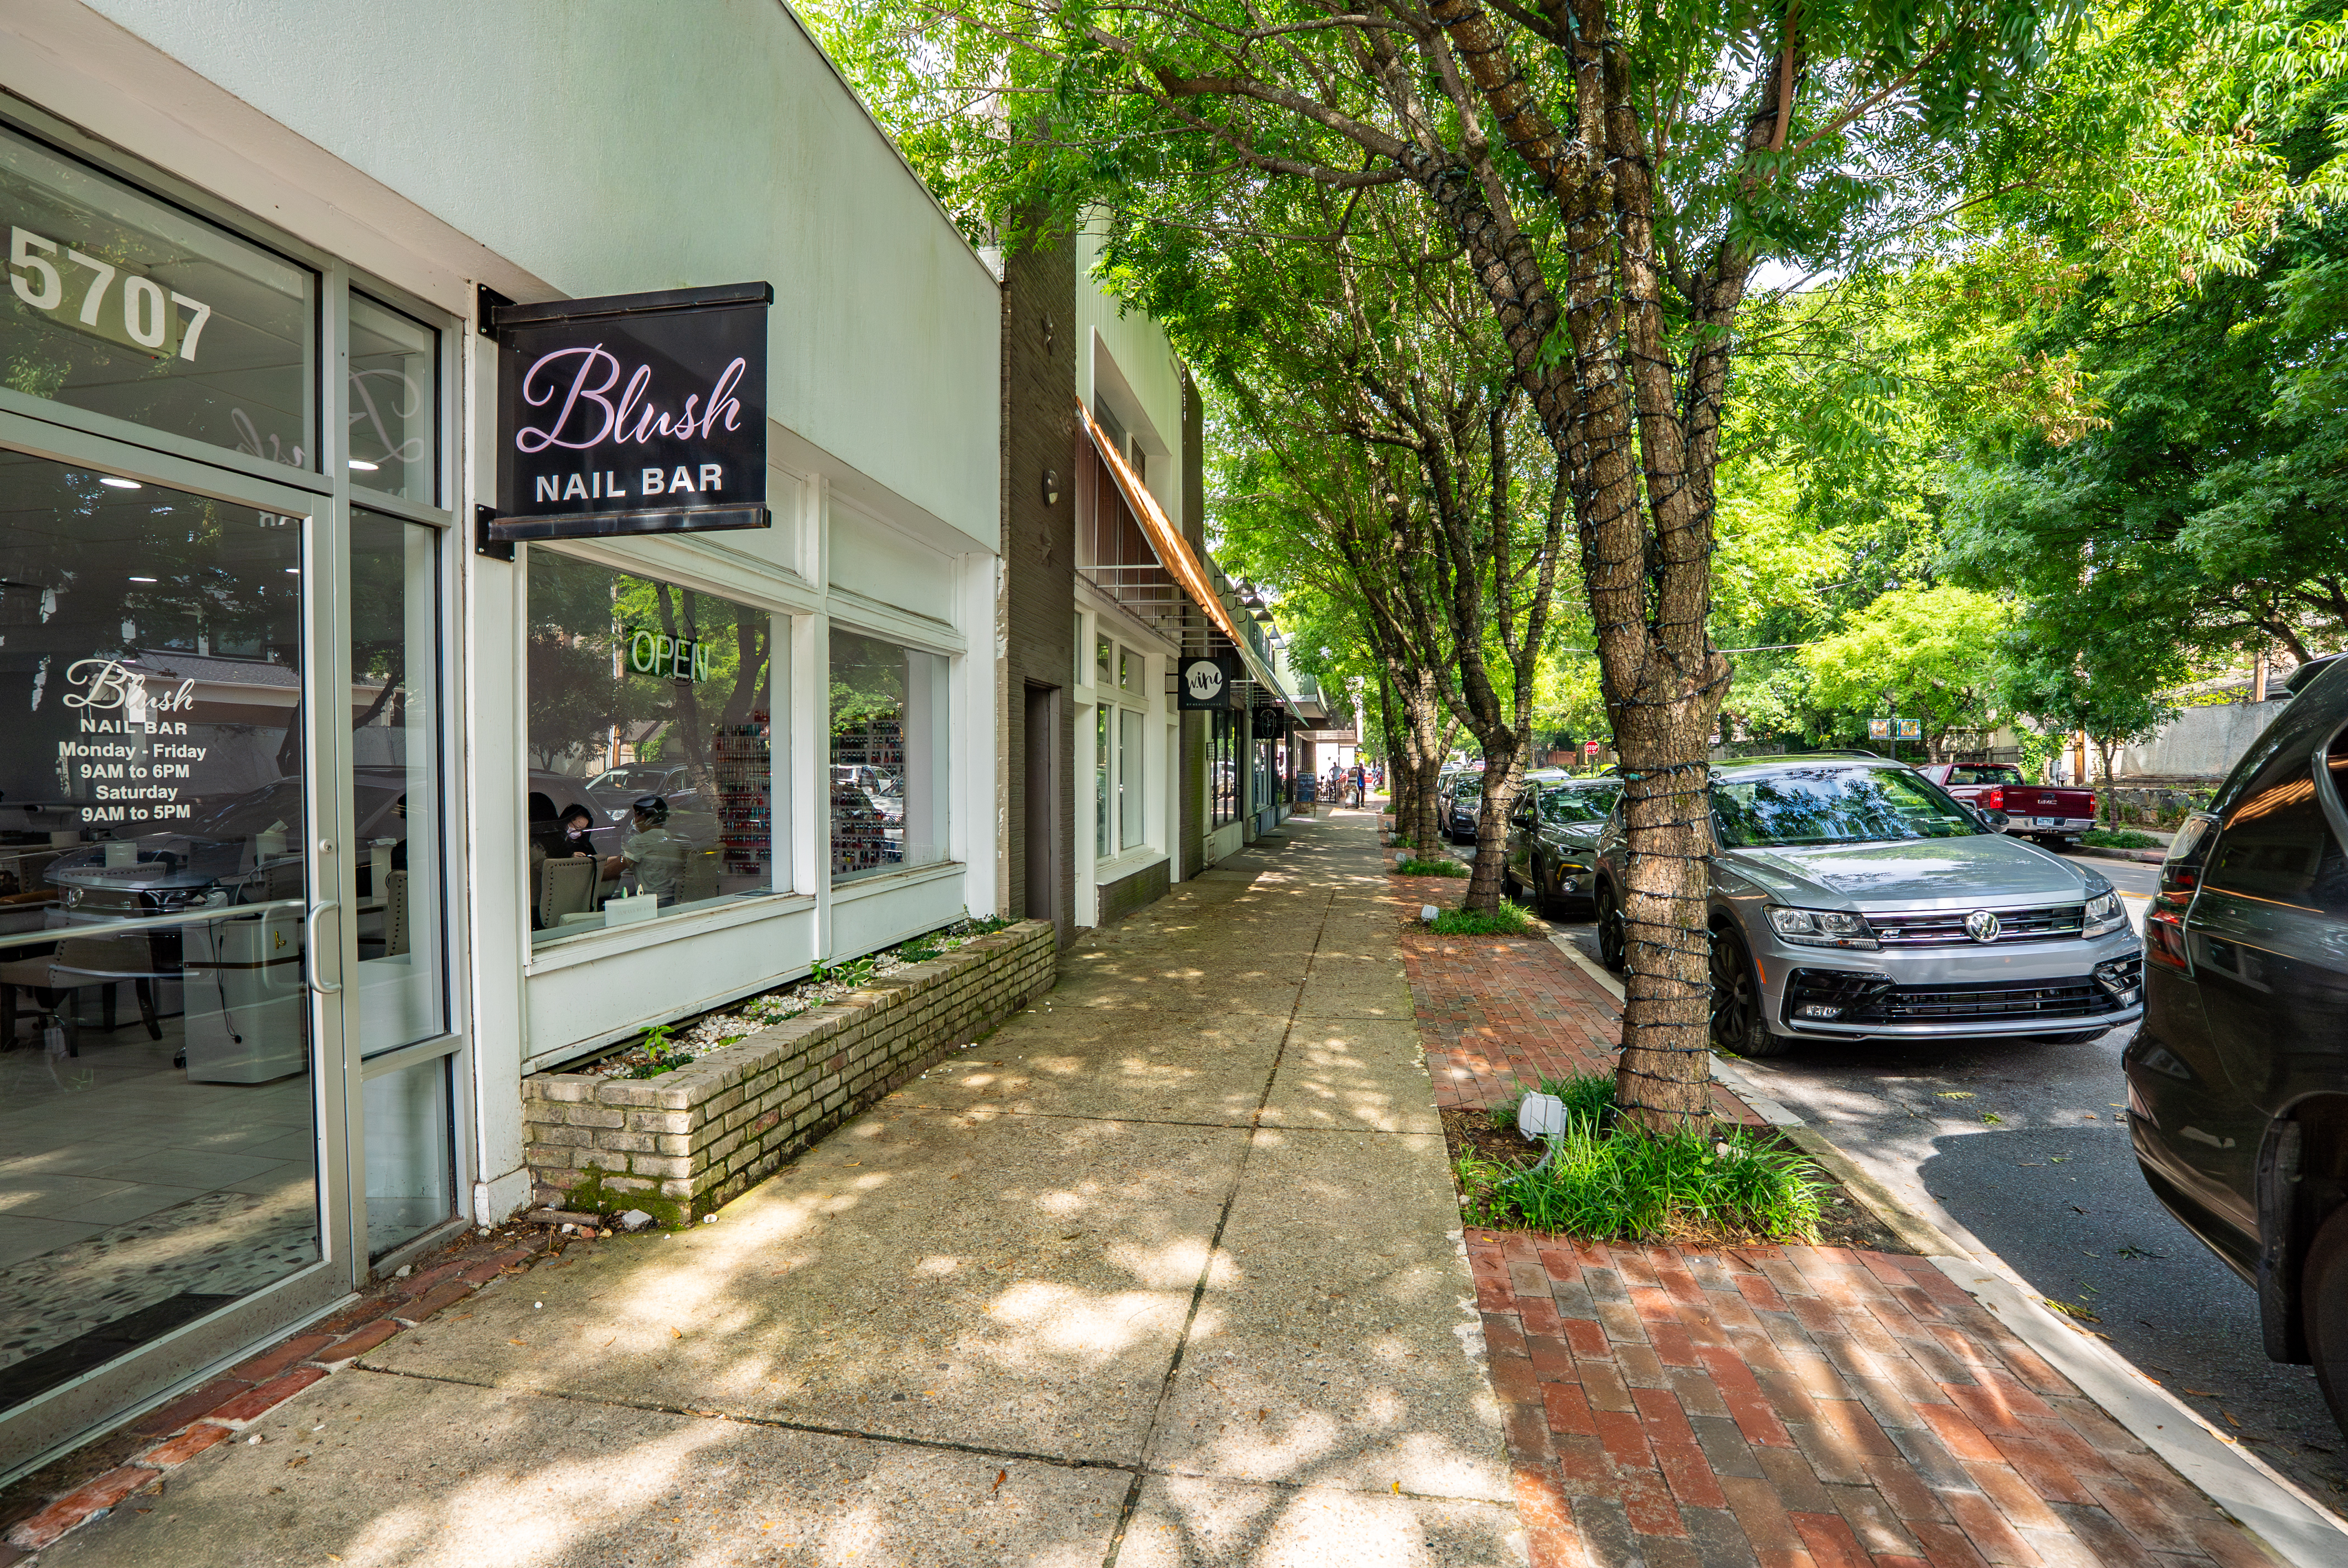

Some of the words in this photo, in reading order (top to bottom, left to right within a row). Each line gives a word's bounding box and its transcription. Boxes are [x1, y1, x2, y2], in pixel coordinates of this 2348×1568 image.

[10, 225, 212, 362] 5707
[516, 343, 746, 453] Blush
[536, 471, 626, 502] NAIL
[642, 463, 722, 496] BAR
[632, 630, 709, 682] OPEN
[62, 659, 194, 712] Blush
[80, 719, 136, 734] NAIL
[144, 721, 188, 736] BAR
[59, 741, 136, 760] Monday
[153, 744, 207, 761] Friday
[80, 765, 124, 778] 9AM
[129, 765, 148, 778] to
[152, 765, 190, 778] 6PM
[95, 785, 178, 802] Saturday
[82, 807, 125, 822] 9AM
[130, 807, 148, 821] to
[153, 804, 190, 819] 5PM
